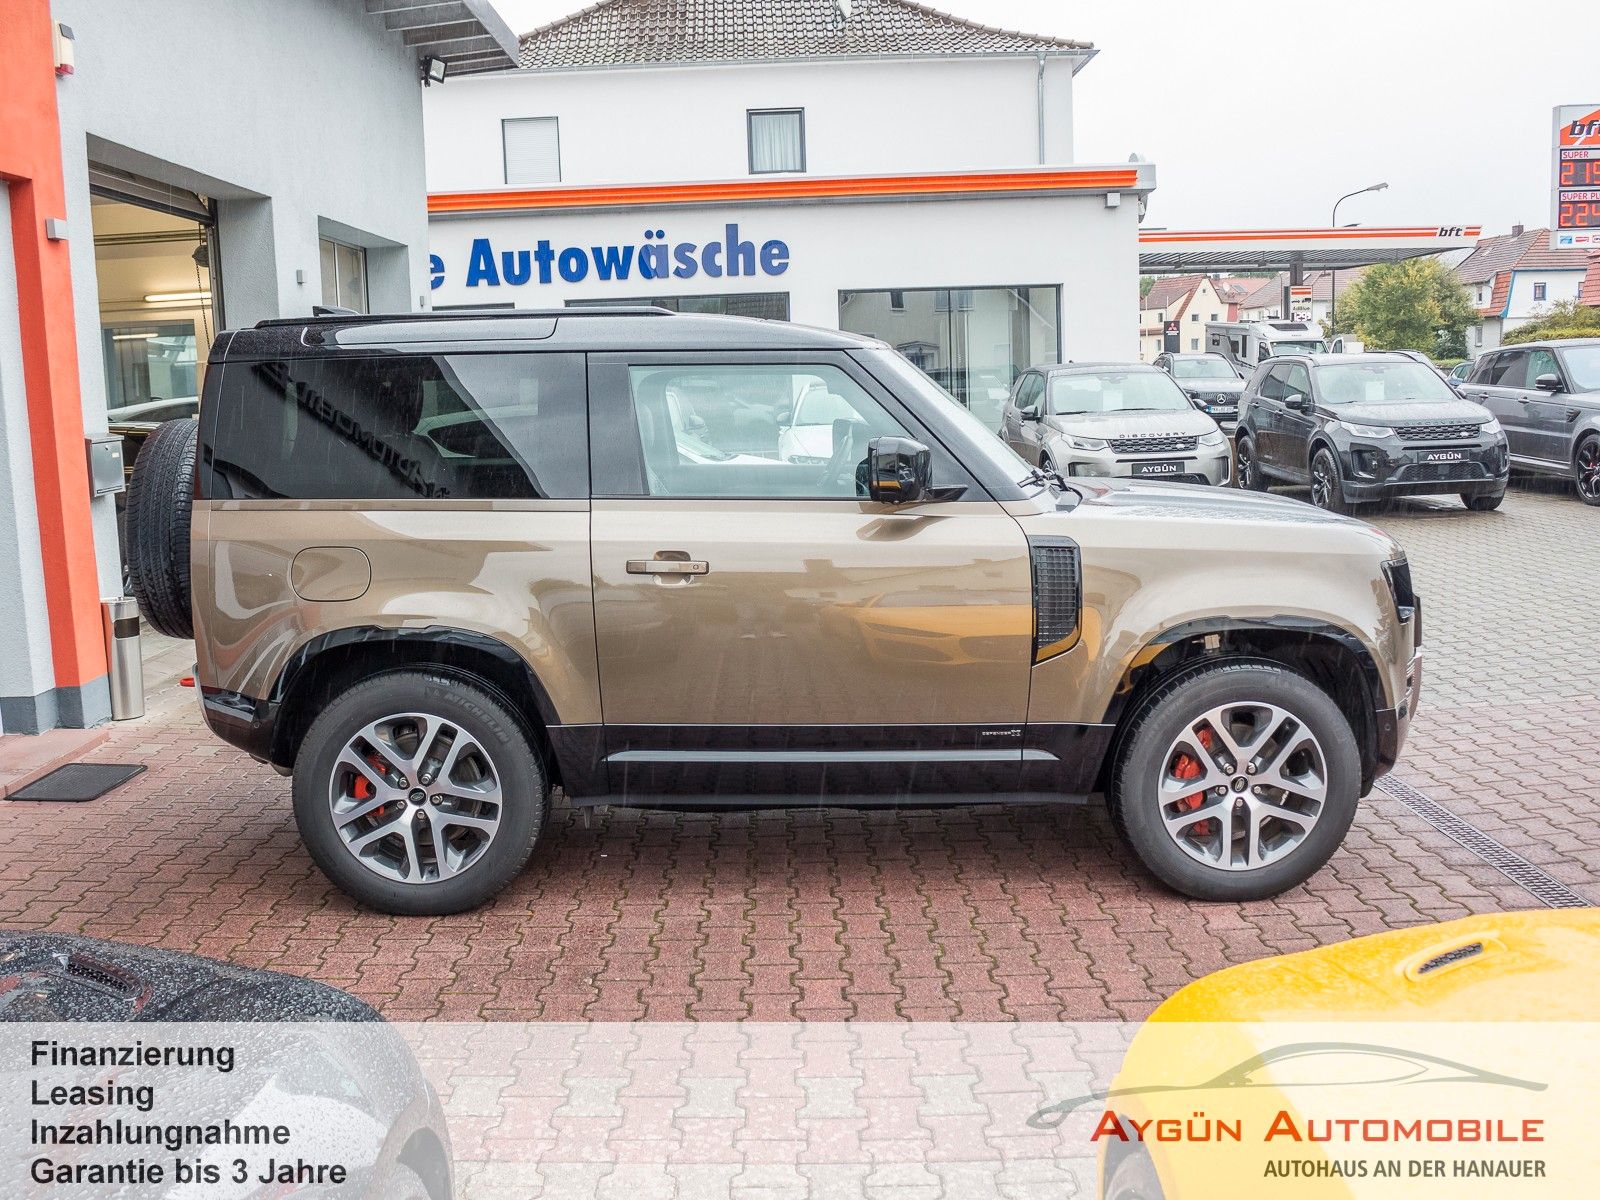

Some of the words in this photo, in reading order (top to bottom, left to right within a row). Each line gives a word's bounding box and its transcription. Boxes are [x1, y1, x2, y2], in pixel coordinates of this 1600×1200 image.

[1562, 151, 1589, 159] SUPER
[1562, 192, 1588, 200] SUPER
[1438, 226, 1463, 237] bft
[466, 223, 789, 288] Autowäsche
[1119, 431, 1187, 439] DISCOVERY
[1427, 451, 1462, 461] AYGÜN
[1141, 463, 1177, 473] AYGÜN
